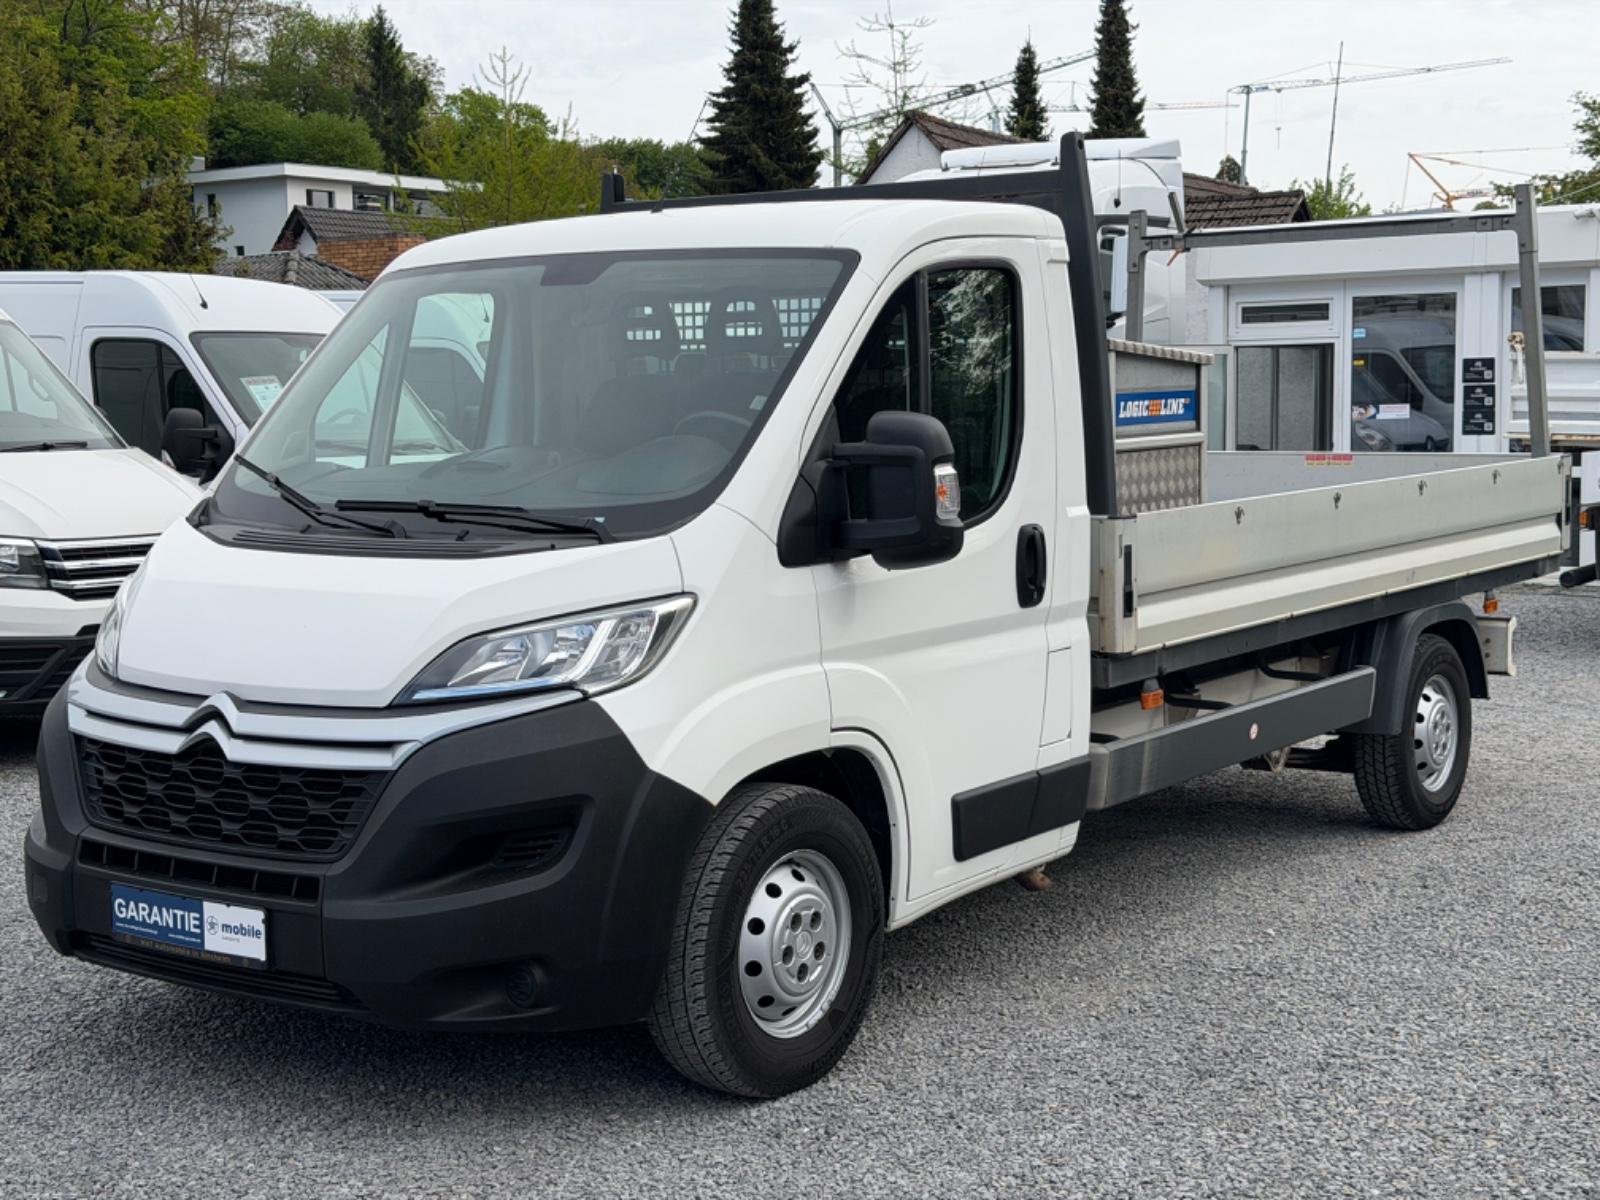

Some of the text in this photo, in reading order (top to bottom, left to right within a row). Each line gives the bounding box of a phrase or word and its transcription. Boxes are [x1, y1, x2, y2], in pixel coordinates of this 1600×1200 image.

[1119, 398, 1185, 418] LOGIC LINE
[114, 898, 201, 933] GARANTIE
[221, 922, 262, 939] mobile
